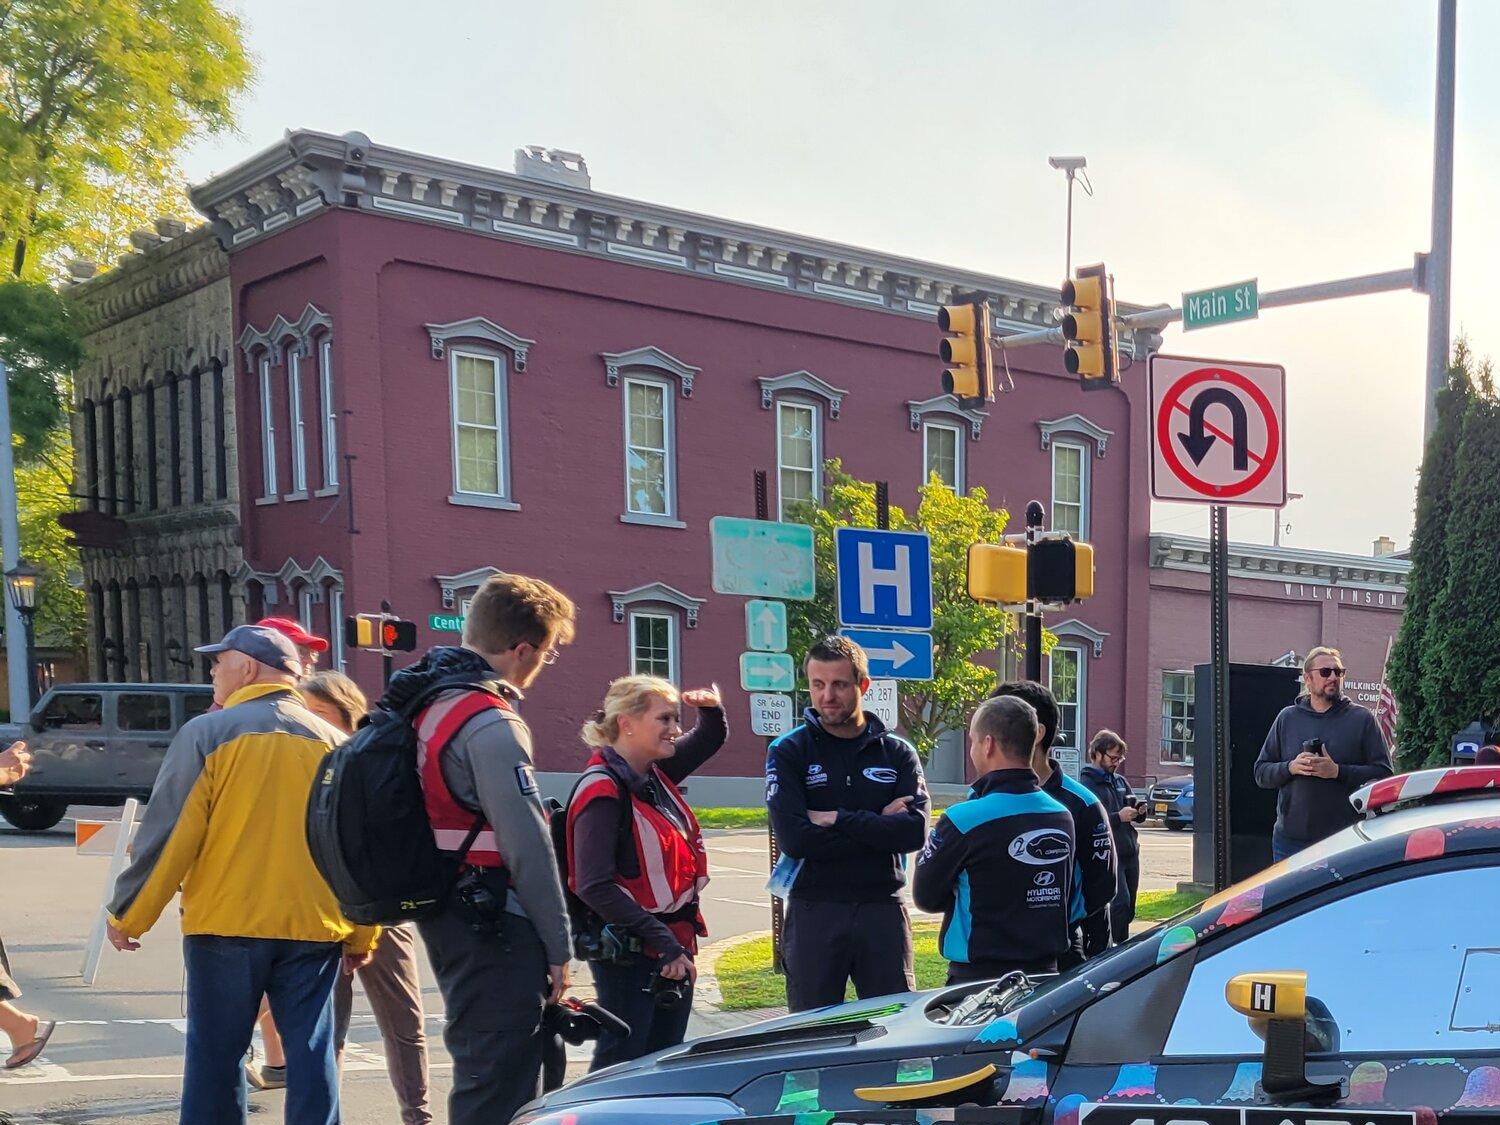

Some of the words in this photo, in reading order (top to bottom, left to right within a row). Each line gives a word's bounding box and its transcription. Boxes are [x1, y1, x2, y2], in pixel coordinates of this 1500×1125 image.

[1188, 294, 1227, 321] Main
[1234, 286, 1251, 312] St
[857, 541, 913, 617] H
[1284, 583, 1397, 606] WILKINSON
[433, 616, 461, 630] Cent
[1344, 681, 1381, 691] WILKINSO
[877, 687, 892, 701] 287
[1357, 693, 1380, 702] COMP
[756, 698, 767, 707] SR
[770, 700, 786, 708] 660
[761, 710, 781, 720] END
[762, 722, 781, 733] SEG
[1027, 887, 1061, 896] HYUNDAI
[1026, 894, 1061, 902] MOTORSPORT
[1254, 983, 1272, 1011] H
